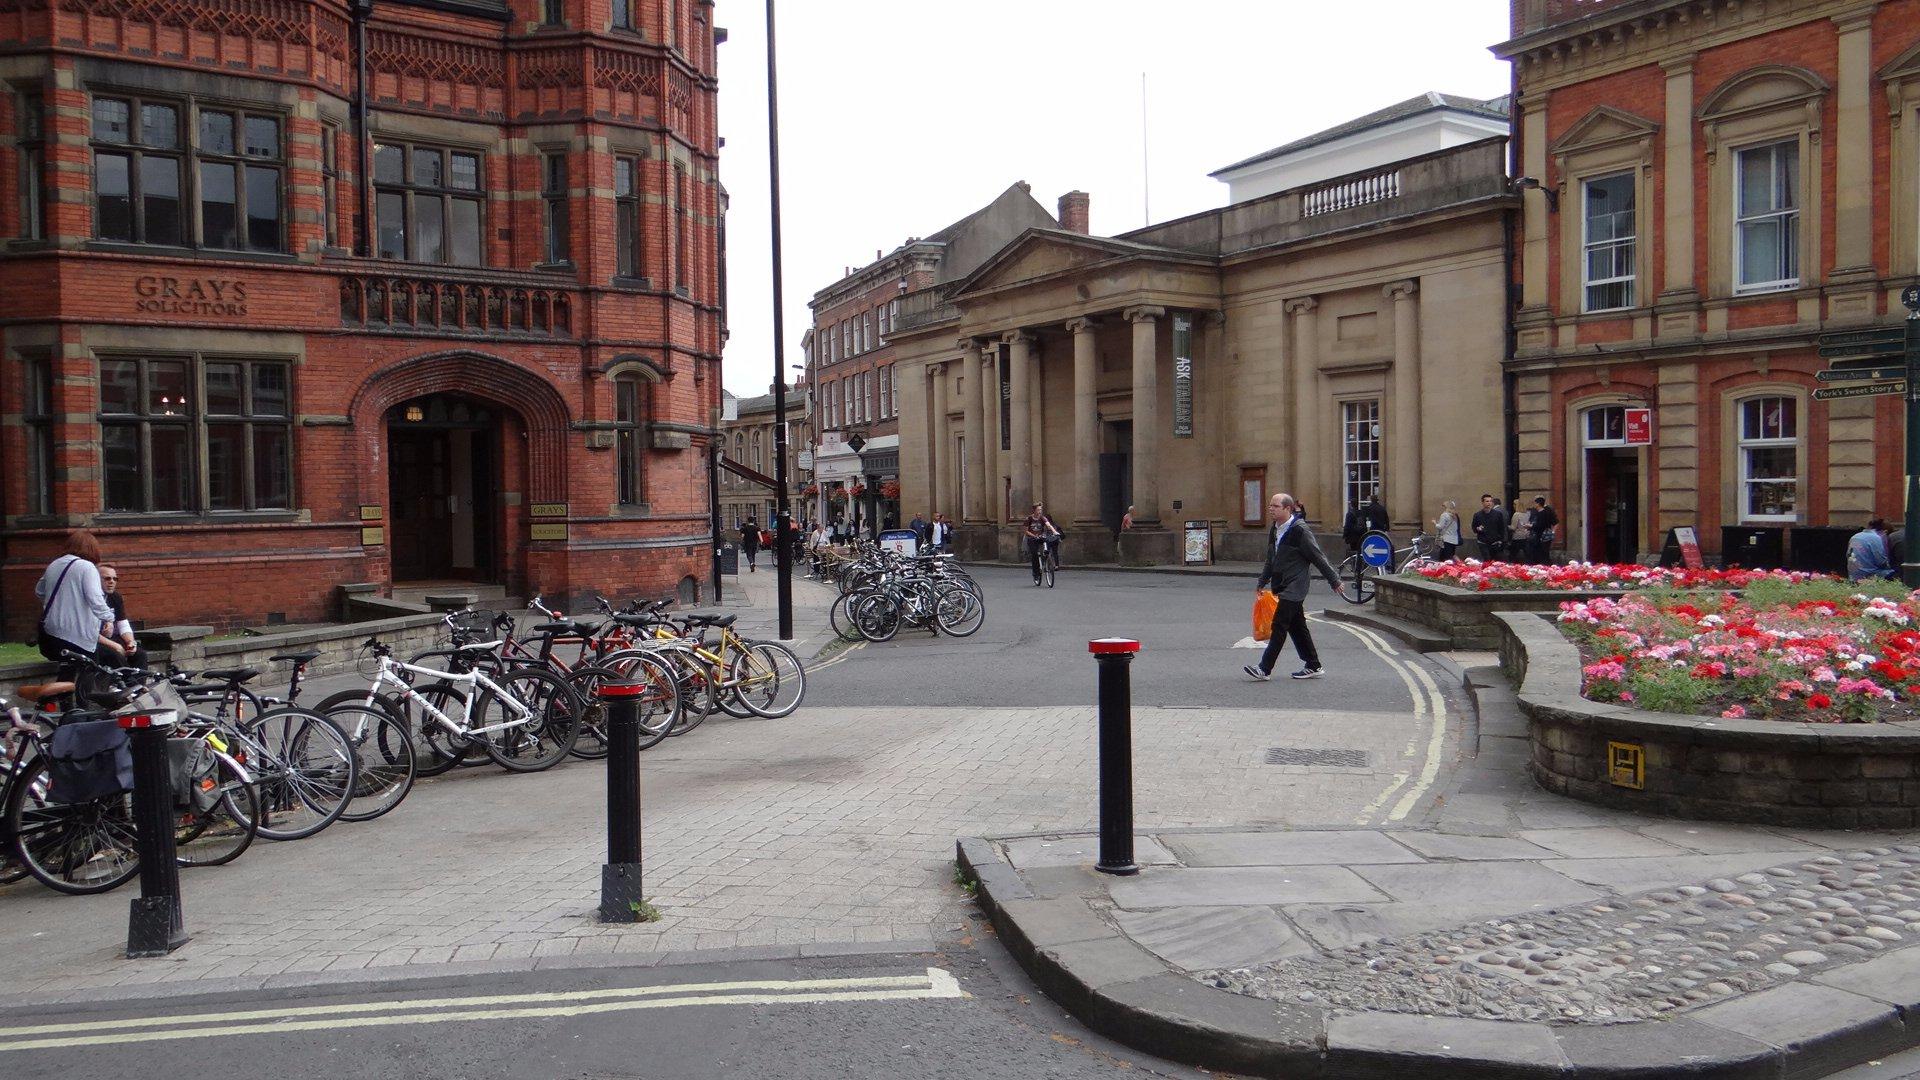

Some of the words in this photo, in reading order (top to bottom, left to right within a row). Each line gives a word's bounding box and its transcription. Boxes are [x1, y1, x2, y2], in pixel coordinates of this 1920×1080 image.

[135, 276, 247, 302] GRAYS
[135, 300, 248, 316] SOLICITORS
[1176, 356, 1191, 379] ASK
[1818, 389, 1842, 398] York's
[1844, 387, 1868, 396] Sweet
[1870, 385, 1892, 395] Story
[533, 506, 564, 515] GRAYS
